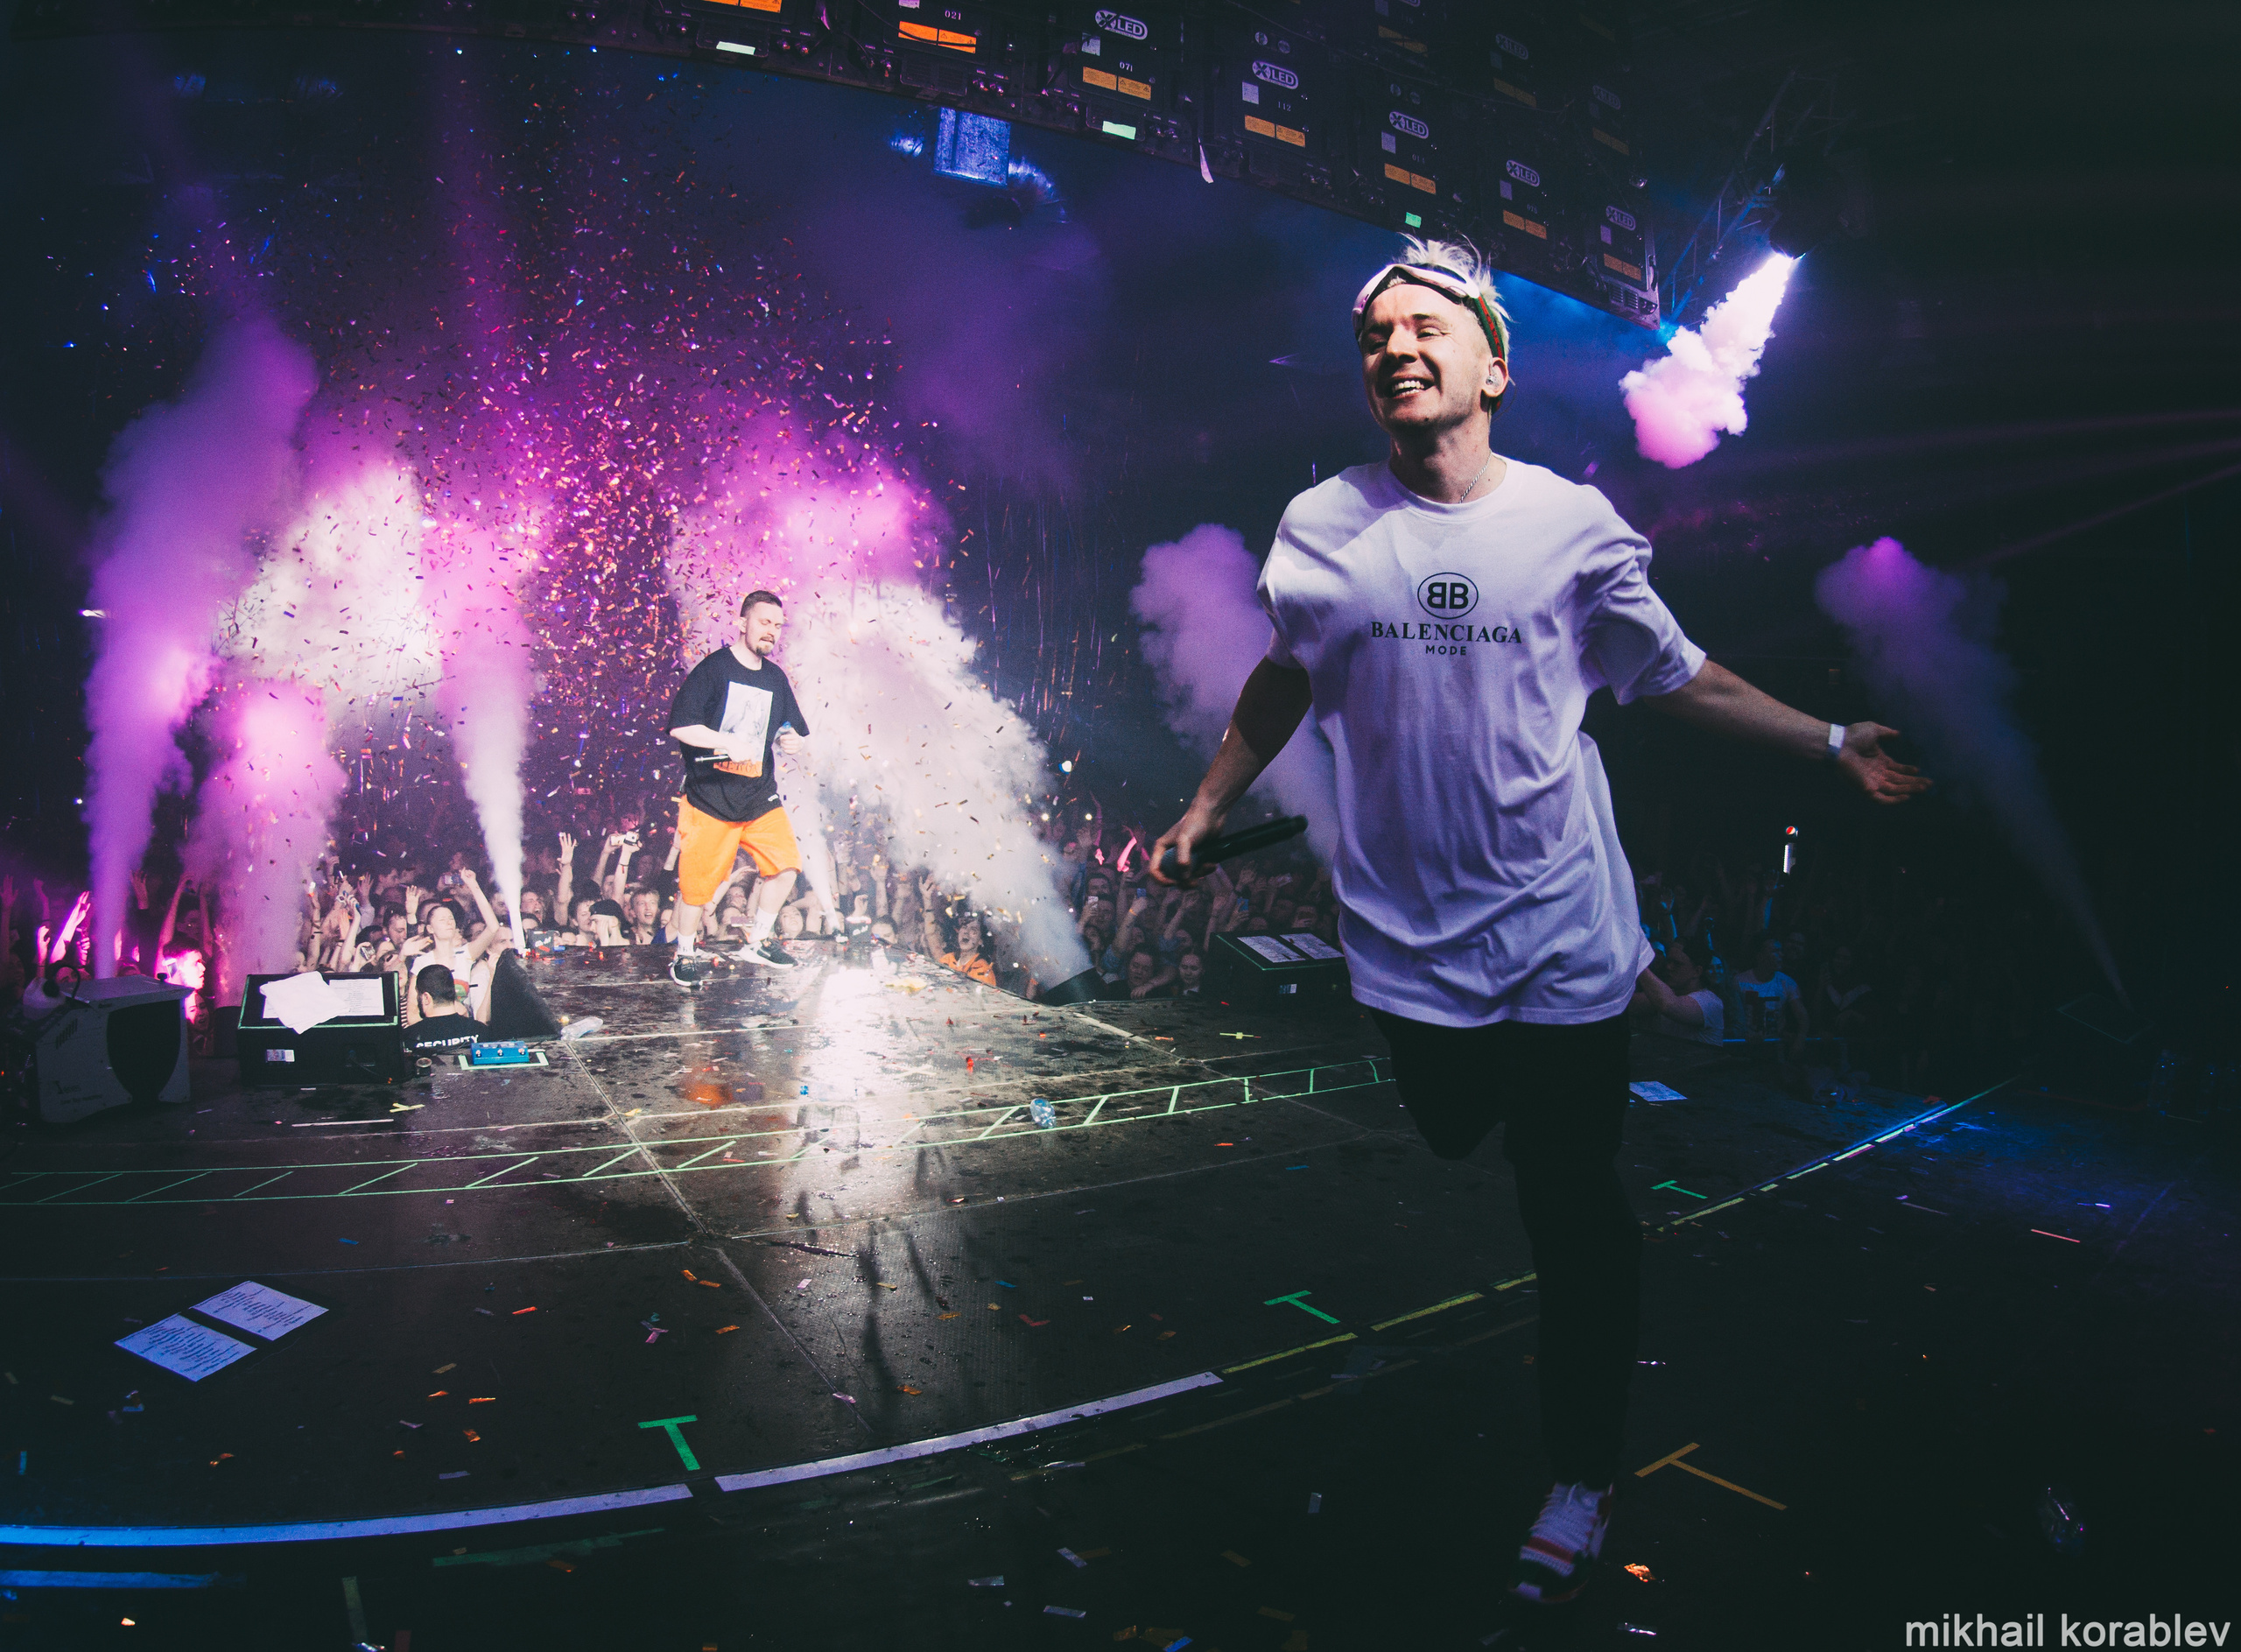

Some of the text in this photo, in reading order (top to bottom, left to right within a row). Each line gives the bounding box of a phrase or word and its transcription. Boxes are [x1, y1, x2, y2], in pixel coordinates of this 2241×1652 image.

[945, 10, 961, 20] 021
[1119, 61, 1133, 72] 071
[1371, 622, 1522, 643] BALENCIAGA
[1425, 645, 1466, 656] MODE
